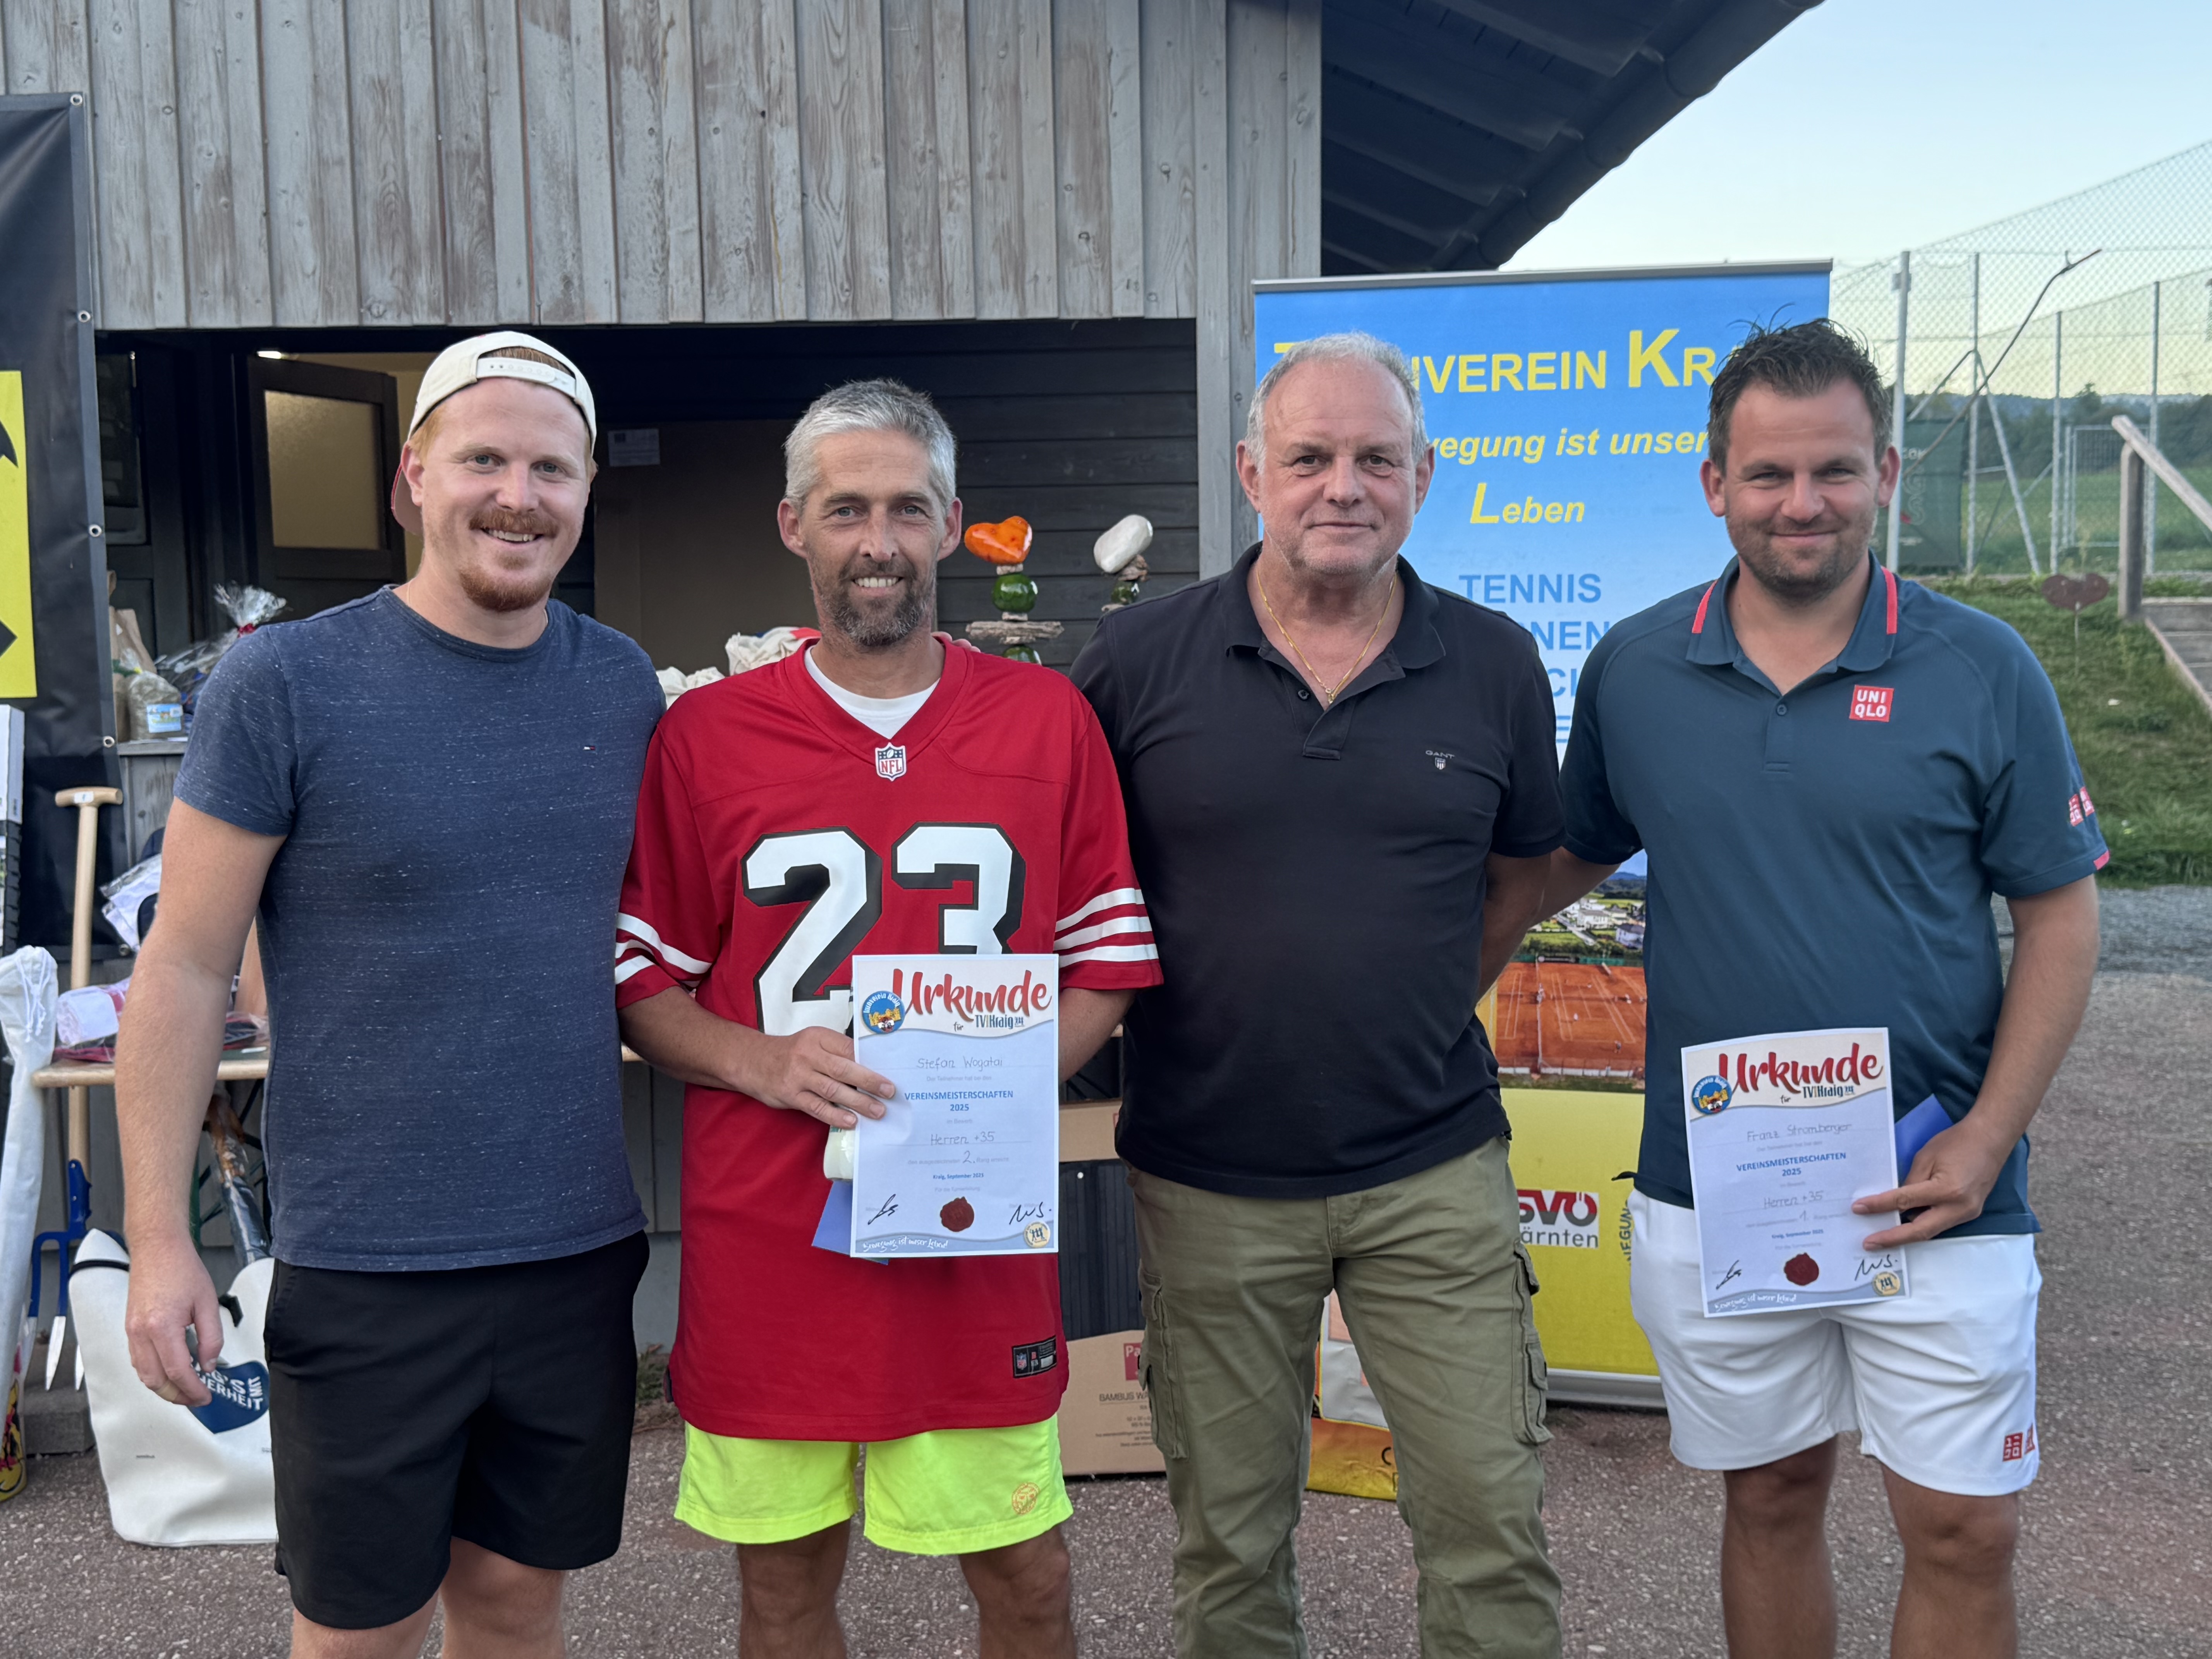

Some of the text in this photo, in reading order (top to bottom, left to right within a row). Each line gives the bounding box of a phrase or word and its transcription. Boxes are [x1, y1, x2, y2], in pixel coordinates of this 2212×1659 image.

[1556, 428, 1599, 456] ist
[1610, 431, 1708, 454] unser
[1470, 483, 1585, 524] Leben
[1459, 574, 1601, 603] TENNIS
[1857, 689, 1887, 704] UNI
[1855, 703, 1887, 718] QLO
[881, 759, 902, 774] NFL
[741, 821, 1026, 1036] 23
[892, 968, 1053, 1022] Urkunde
[917, 1057, 955, 1071] Stefan
[1719, 1042, 1883, 1094] Urkunde
[904, 1090, 1013, 1101] VEREINSMEISTERSCHAFTEN
[930, 1133, 969, 1146] Herren
[1747, 1130, 1780, 1142] Franz
[1736, 1152, 1846, 1172] VEREINSMEISTERSCHAFTEN
[1782, 1168, 1802, 1176] 2025
[1517, 1189, 1597, 1226] SVÖ
[1764, 1197, 1799, 1209] Herren
[1521, 1226, 1599, 1248] ärnten
